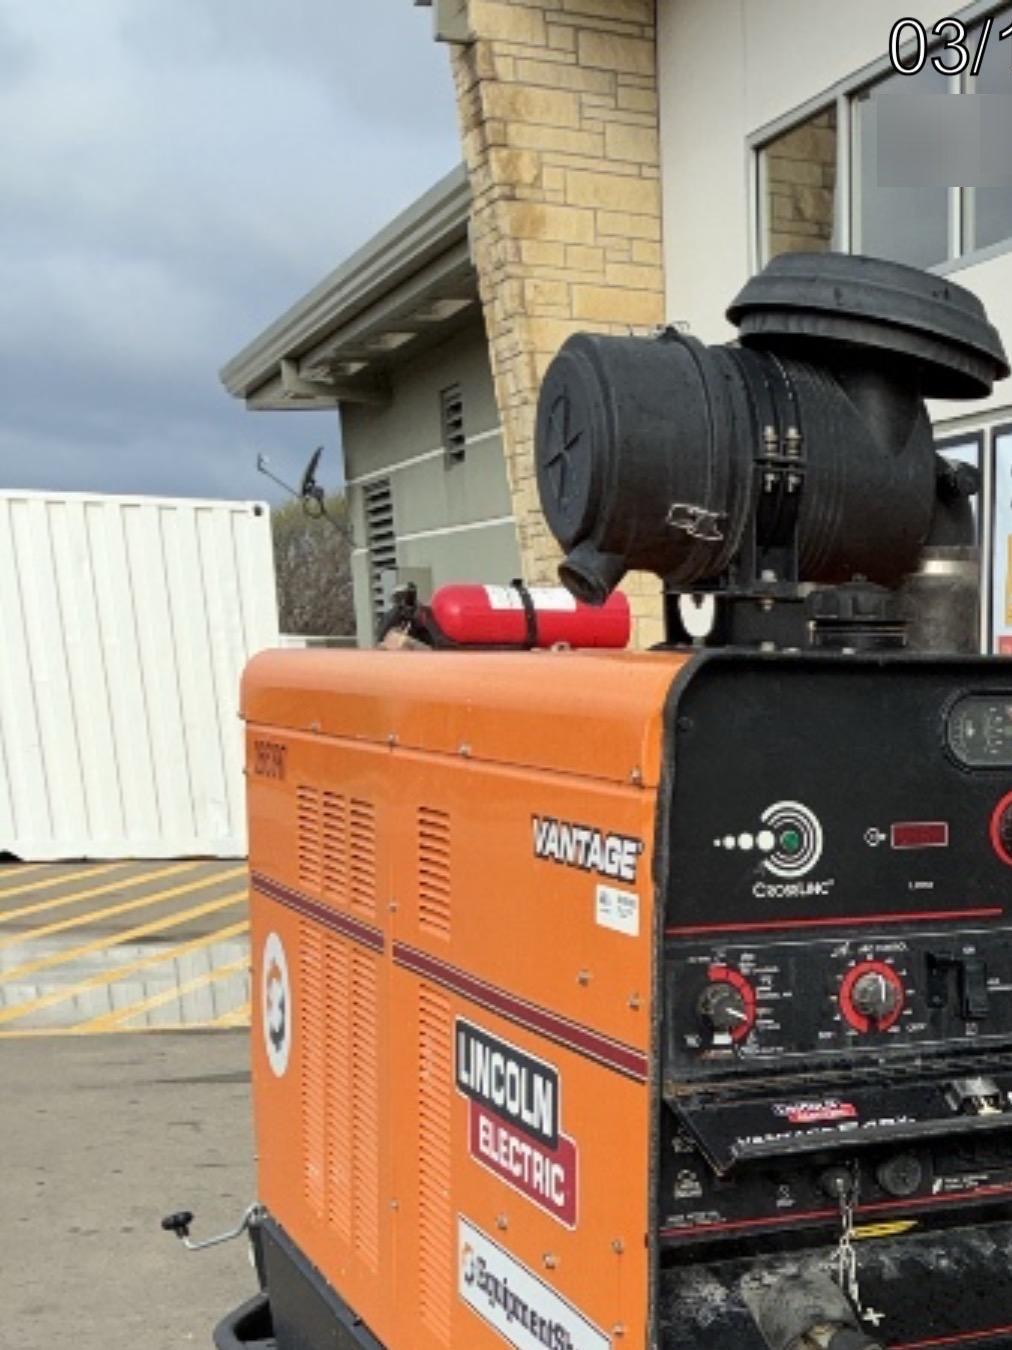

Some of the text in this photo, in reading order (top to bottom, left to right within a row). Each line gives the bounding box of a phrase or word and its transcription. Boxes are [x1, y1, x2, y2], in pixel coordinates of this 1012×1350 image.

[531, 813, 638, 884] VANTAGE
[458, 1031, 553, 1138] LINCOLN
[479, 1114, 566, 1206] ELECTRIC
